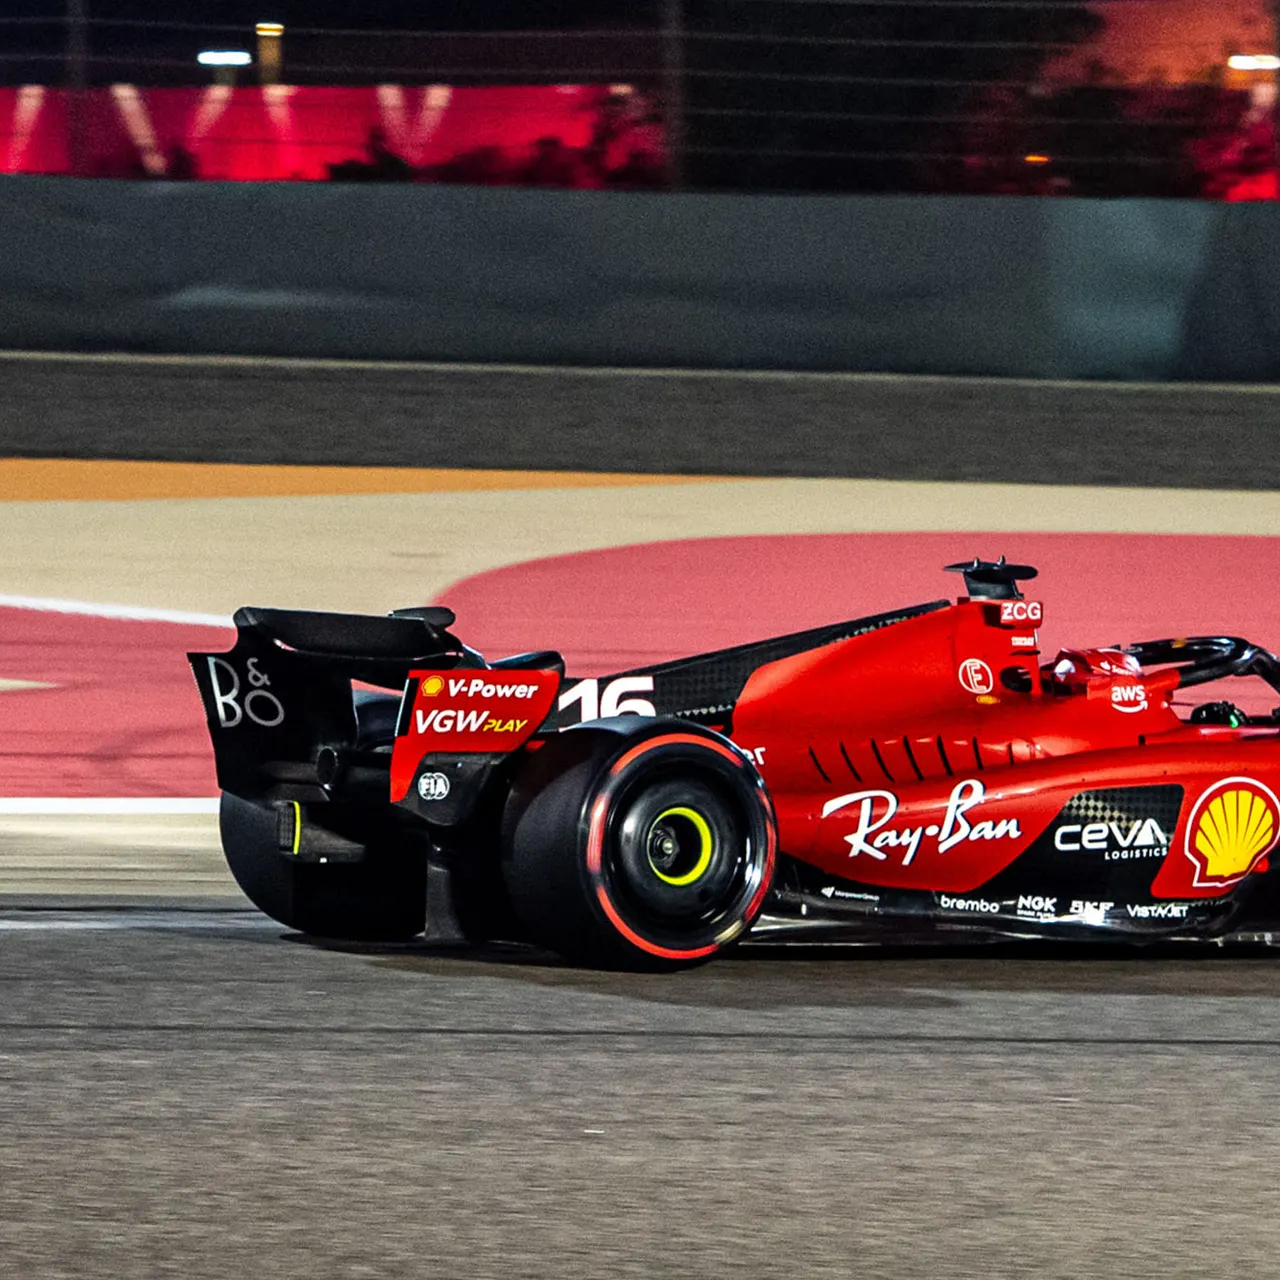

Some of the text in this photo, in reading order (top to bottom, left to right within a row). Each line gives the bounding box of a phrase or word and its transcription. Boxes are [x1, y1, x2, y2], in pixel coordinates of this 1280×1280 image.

[1001, 601, 1041, 620] ZCG
[448, 678, 539, 699] V-Power
[1111, 684, 1146, 702] aws
[558, 676, 657, 732] 16
[415, 709, 528, 734] VGW PLAY
[419, 776, 448, 797] FIA
[1104, 847, 1168, 860] LOGISTICS
[940, 894, 1000, 913] brembo
[1017, 895, 1058, 912] NGK
